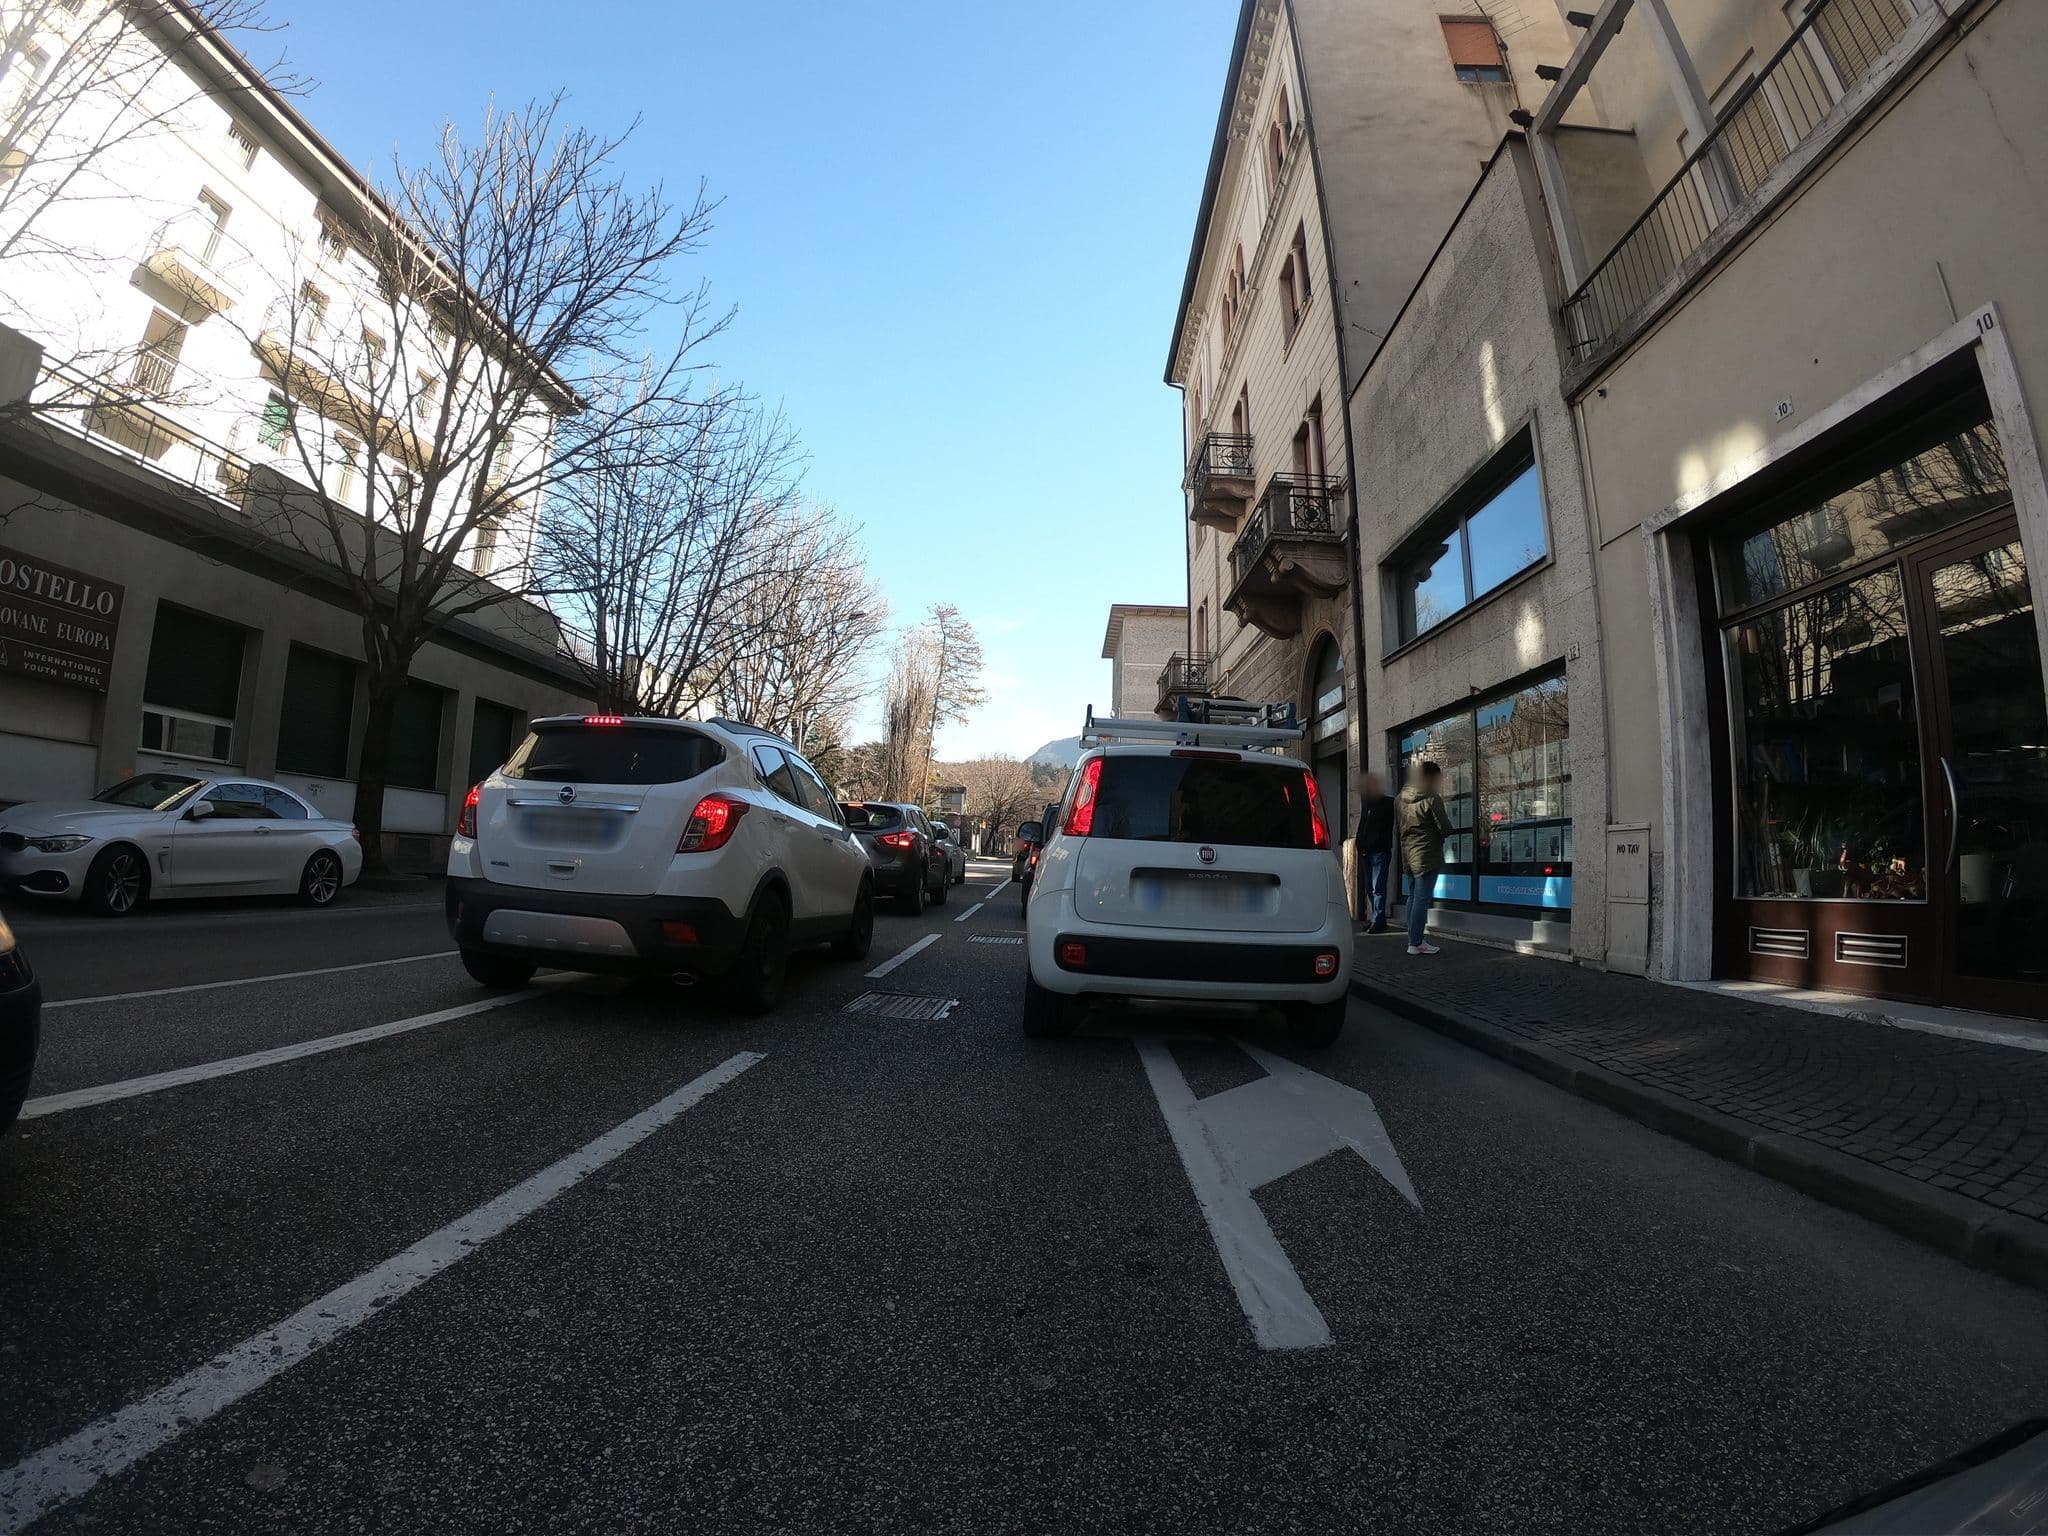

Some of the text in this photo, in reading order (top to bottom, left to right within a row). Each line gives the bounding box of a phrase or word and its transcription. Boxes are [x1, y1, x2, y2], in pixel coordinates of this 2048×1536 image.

[1976, 312, 1994, 334] 10
[1778, 402, 1788, 416] 10
[0, 559, 114, 615] OSTELLO
[0, 606, 111, 650] OVANE EUROPA
[23, 649, 103, 675] INTERNATIONAL
[23, 661, 101, 686] YOUTH HOSTEL
[1201, 849, 1214, 859] FIAT
[1616, 843, 1640, 855] NO TAV
